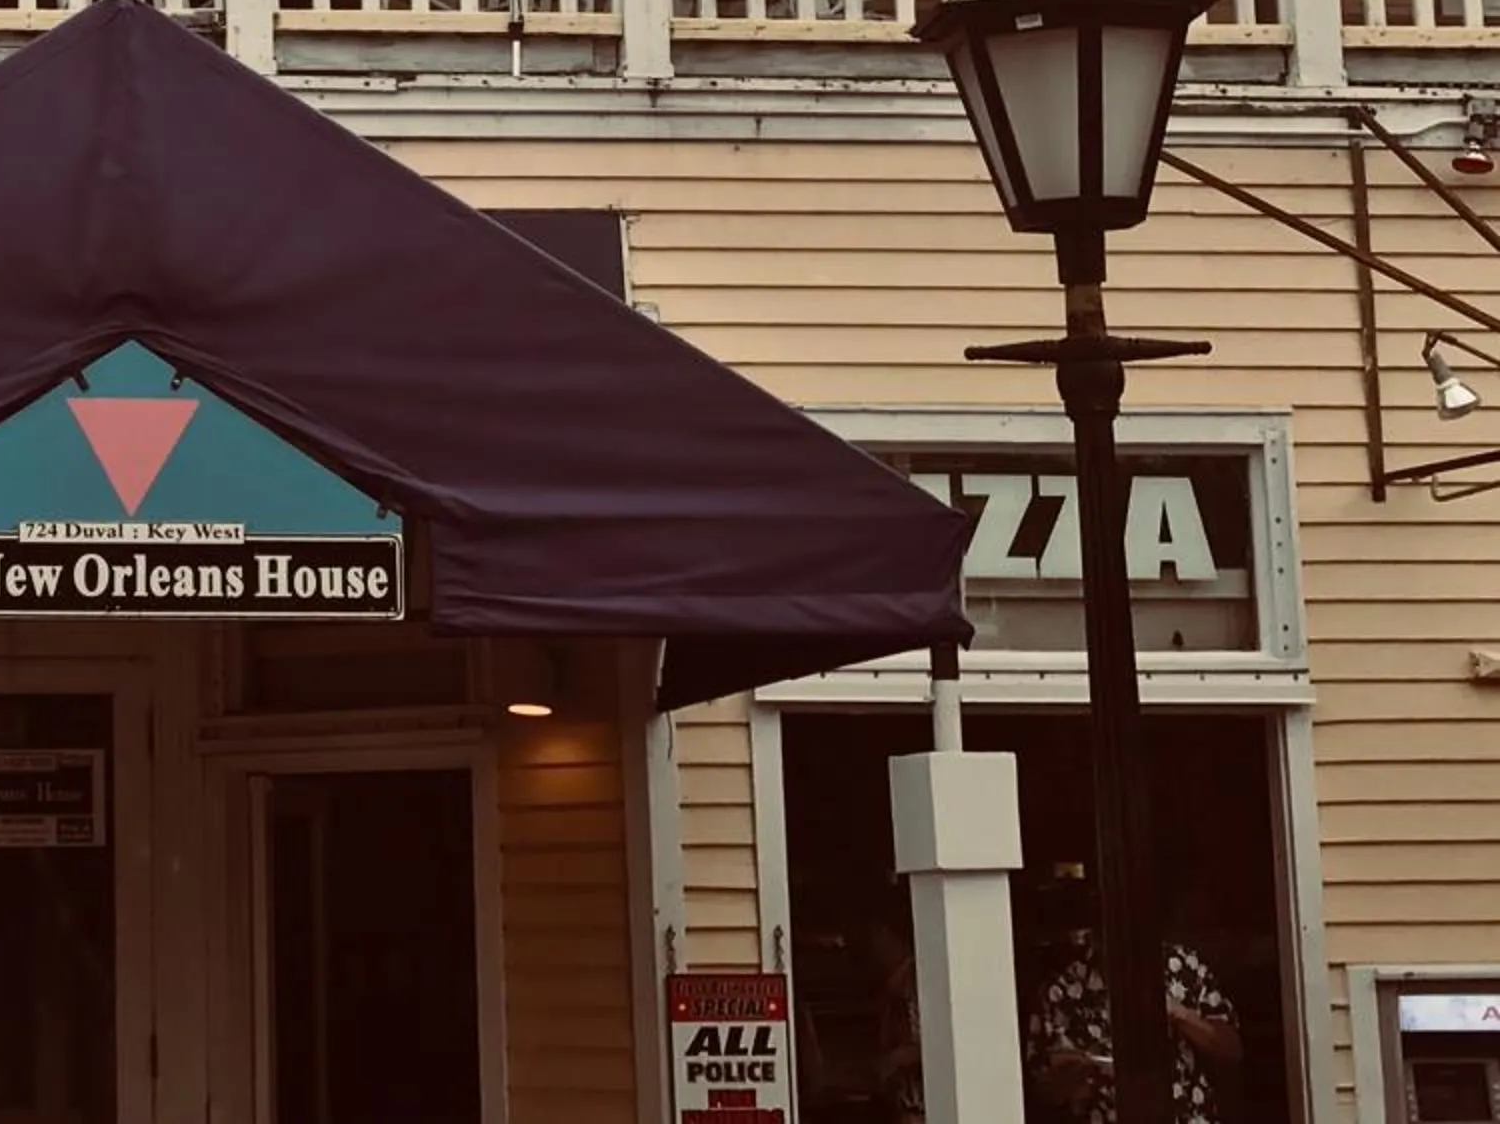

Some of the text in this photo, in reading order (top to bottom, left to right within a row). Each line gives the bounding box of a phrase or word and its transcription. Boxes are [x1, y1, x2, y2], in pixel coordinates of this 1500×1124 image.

[26, 523, 58, 539] 724
[65, 523, 124, 540] Duval
[148, 523, 188, 544] Key
[193, 524, 242, 540] West
[909, 474, 1218, 580] ZZA
[73, 553, 245, 598] Orleans
[253, 554, 389, 599] House
[684, 1026, 778, 1057] ALL
[686, 1061, 777, 1084] POLICE
